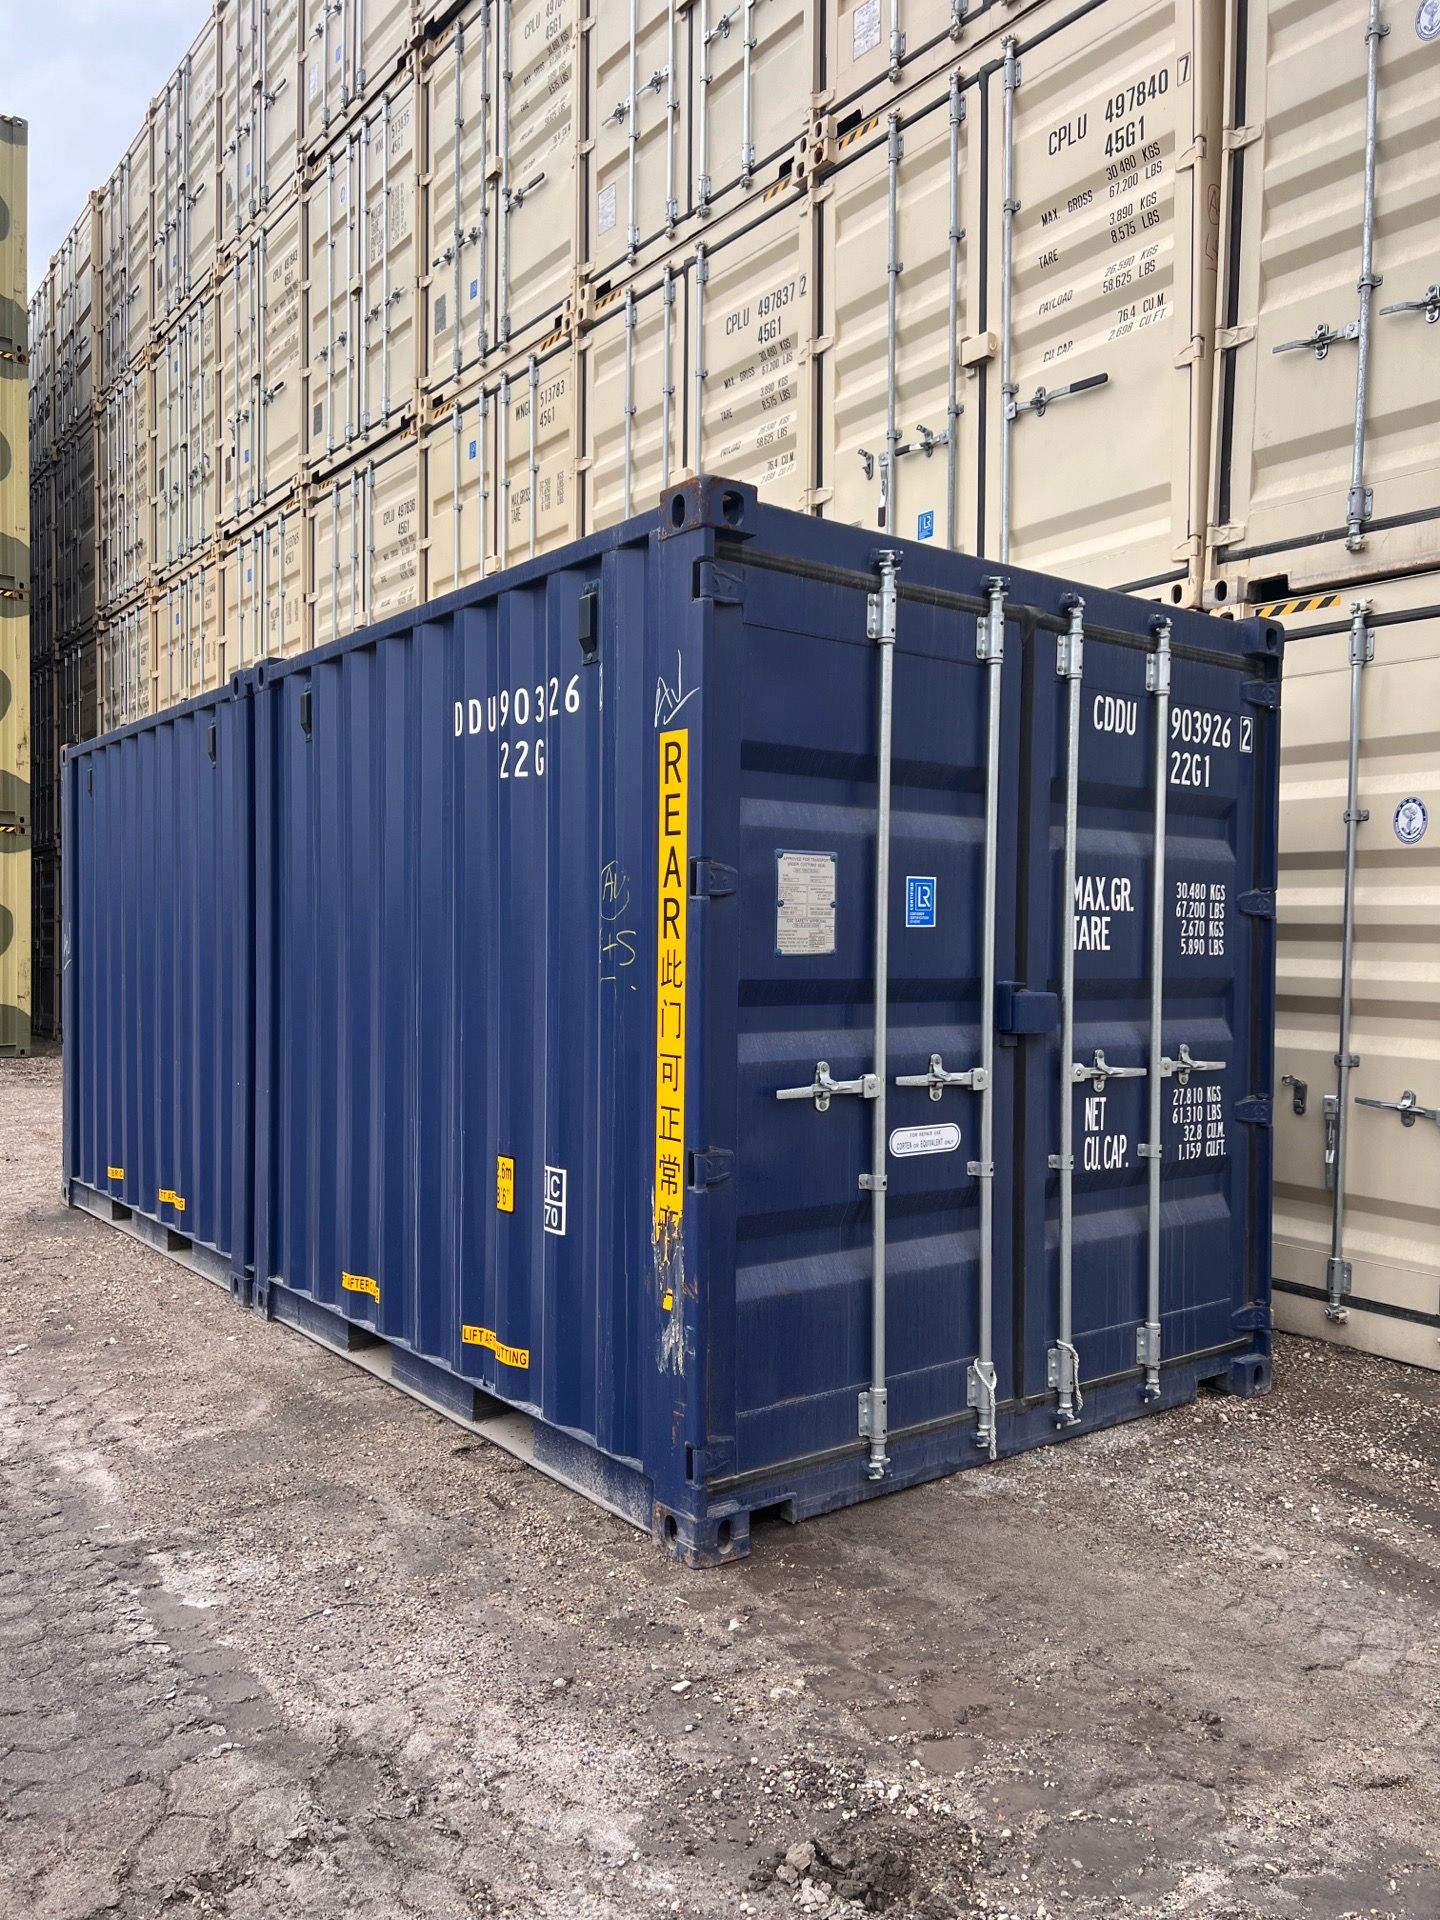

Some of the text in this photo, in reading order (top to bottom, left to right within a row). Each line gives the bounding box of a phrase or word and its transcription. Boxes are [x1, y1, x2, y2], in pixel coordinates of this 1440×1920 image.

[1048, 113, 1088, 156] CPLU
[1105, 68, 1169, 123] 497840
[1104, 115, 1145, 158] 45G1
[1141, 142, 1161, 163] KGS
[1067, 189, 1093, 213] GROSS
[1109, 172, 1139, 198] 67.200
[1145, 160, 1163, 180] LBS
[1109, 191, 1157, 226] 3.890 KGS
[1038, 209, 1160, 269] TARE 8.575 LBS
[1140, 244, 1159, 261] KGS
[1038, 259, 1156, 316] PAYLOAD 58.625 LBS
[726, 307, 750, 336] CPLU
[757, 282, 796, 318] 497837
[758, 315, 782, 345] 45G1
[515, 379, 565, 422] WNG 513783
[779, 388, 791, 402] LBS
[539, 407, 555, 428] 45G1
[1093, 694, 1138, 736] CDDU
[1171, 707, 1232, 749] 903926
[500, 738, 545, 779] 22G
[1170, 750, 1210, 788] 22G1
[663, 740, 682, 940] REAR
[1176, 882, 1207, 900] 30.480
[1209, 884, 1226, 901] KGS
[1175, 901, 1225, 919] 67.200 LBS
[1073, 915, 1225, 951] TARE 2.670 KGS
[1180, 938, 1225, 956] 5.890 LBS
[1084, 1086, 1222, 1132] NET 27.810 KGS
[1172, 1104, 1222, 1124] 61.310 LBS
[1183, 1124, 1203, 1142] 32.8
[1178, 1143, 1202, 1161] 1.159
[545, 1204, 558, 1228] 70
[464, 1329, 484, 1343] LIFT
